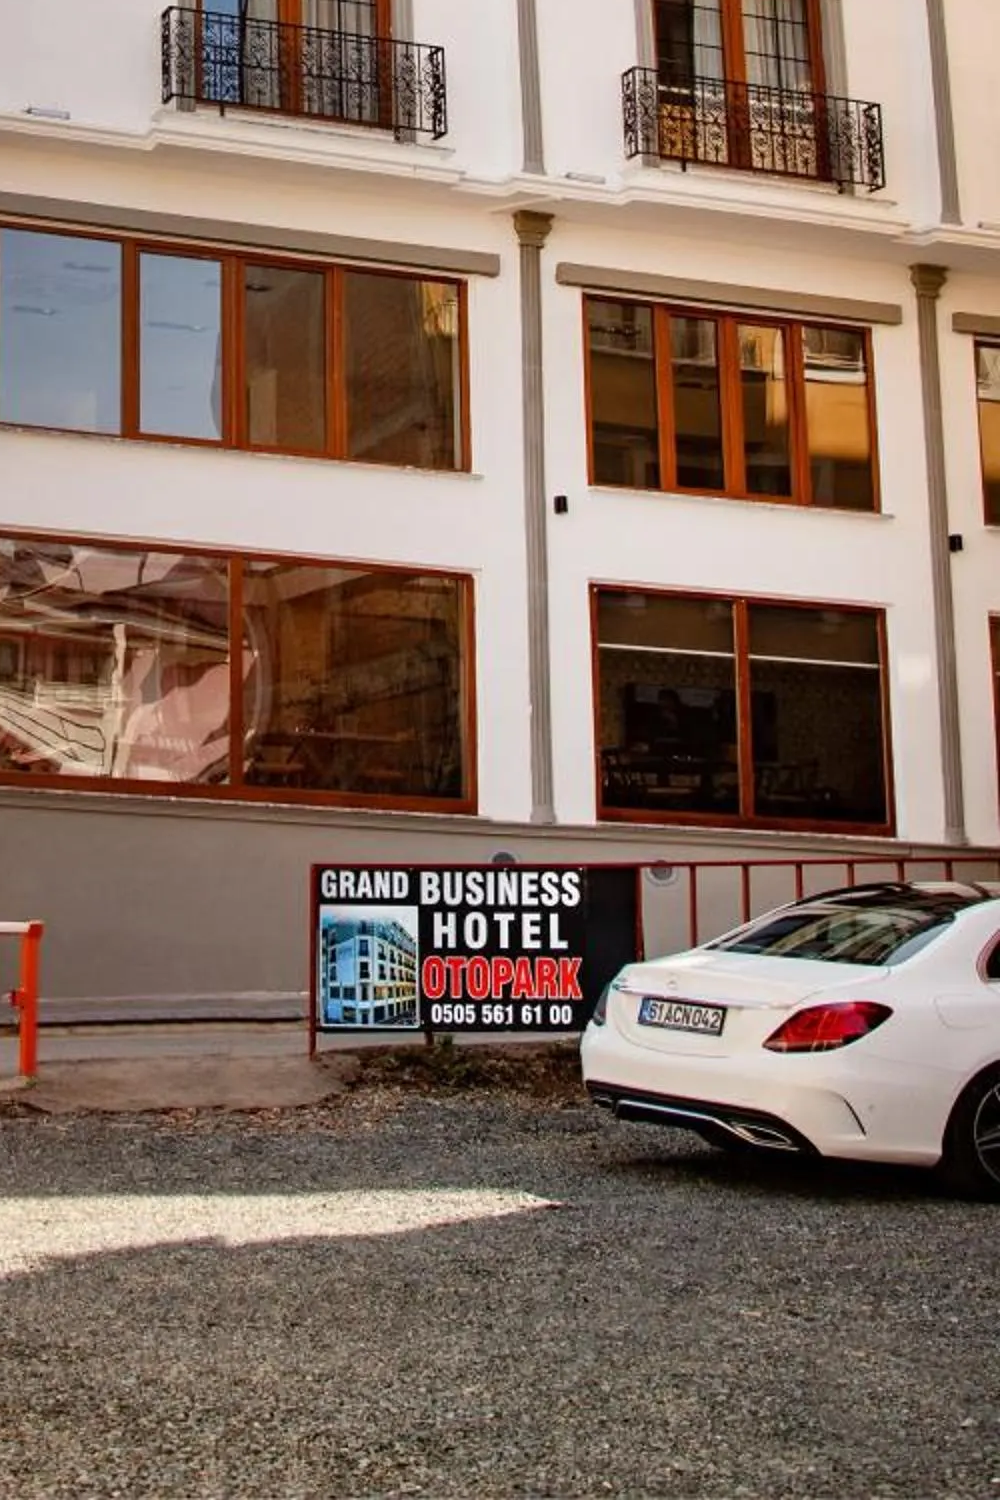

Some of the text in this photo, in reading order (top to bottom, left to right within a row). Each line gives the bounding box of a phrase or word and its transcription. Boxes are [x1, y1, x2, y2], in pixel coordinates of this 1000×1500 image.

[321, 869, 581, 906] GRAND BUSINESS
[433, 912, 568, 949] HOTEL
[422, 955, 582, 999] OTOPARK
[431, 1004, 573, 1025] 0505 561 61 00
